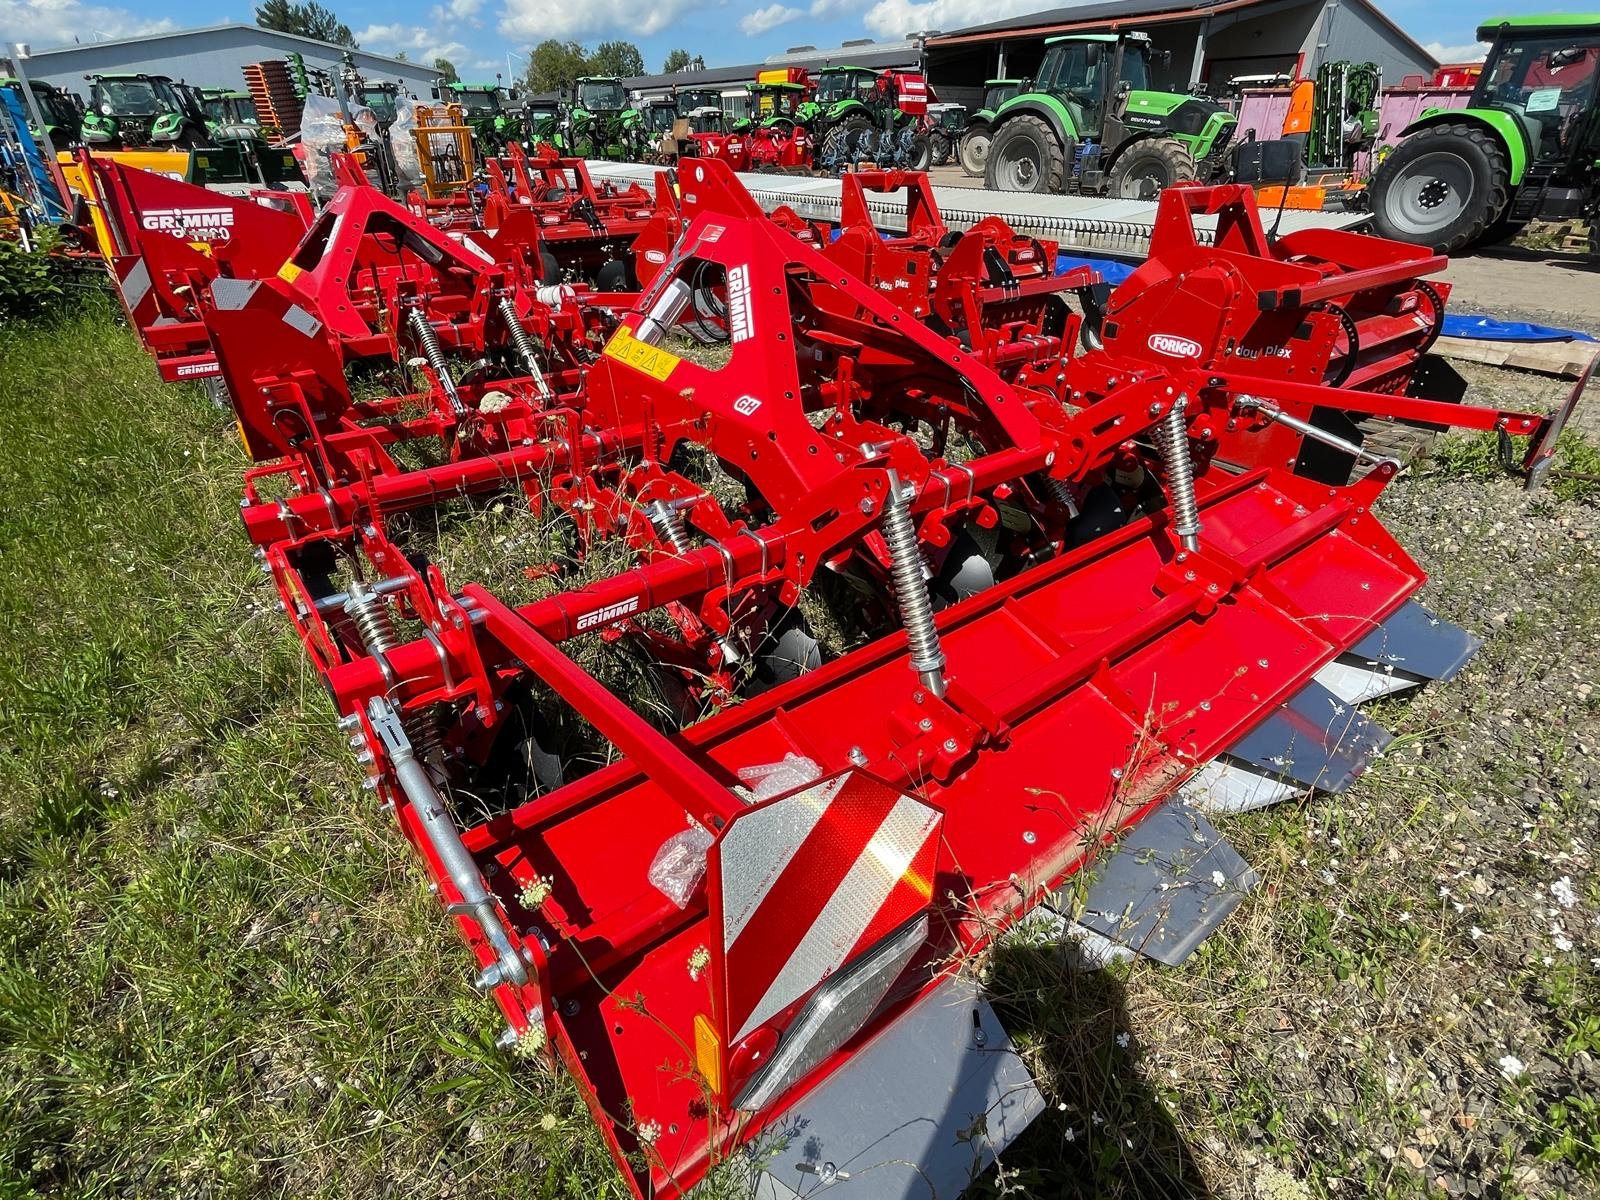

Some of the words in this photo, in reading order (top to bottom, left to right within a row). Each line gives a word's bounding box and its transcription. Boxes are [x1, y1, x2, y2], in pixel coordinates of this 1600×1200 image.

[142, 208, 234, 229] GRIMME
[728, 264, 755, 344] GRIMME
[1152, 336, 1195, 356] FORIGO
[177, 362, 220, 376] GRIMME
[736, 398, 759, 413] GH
[576, 596, 639, 630] GRIMME
